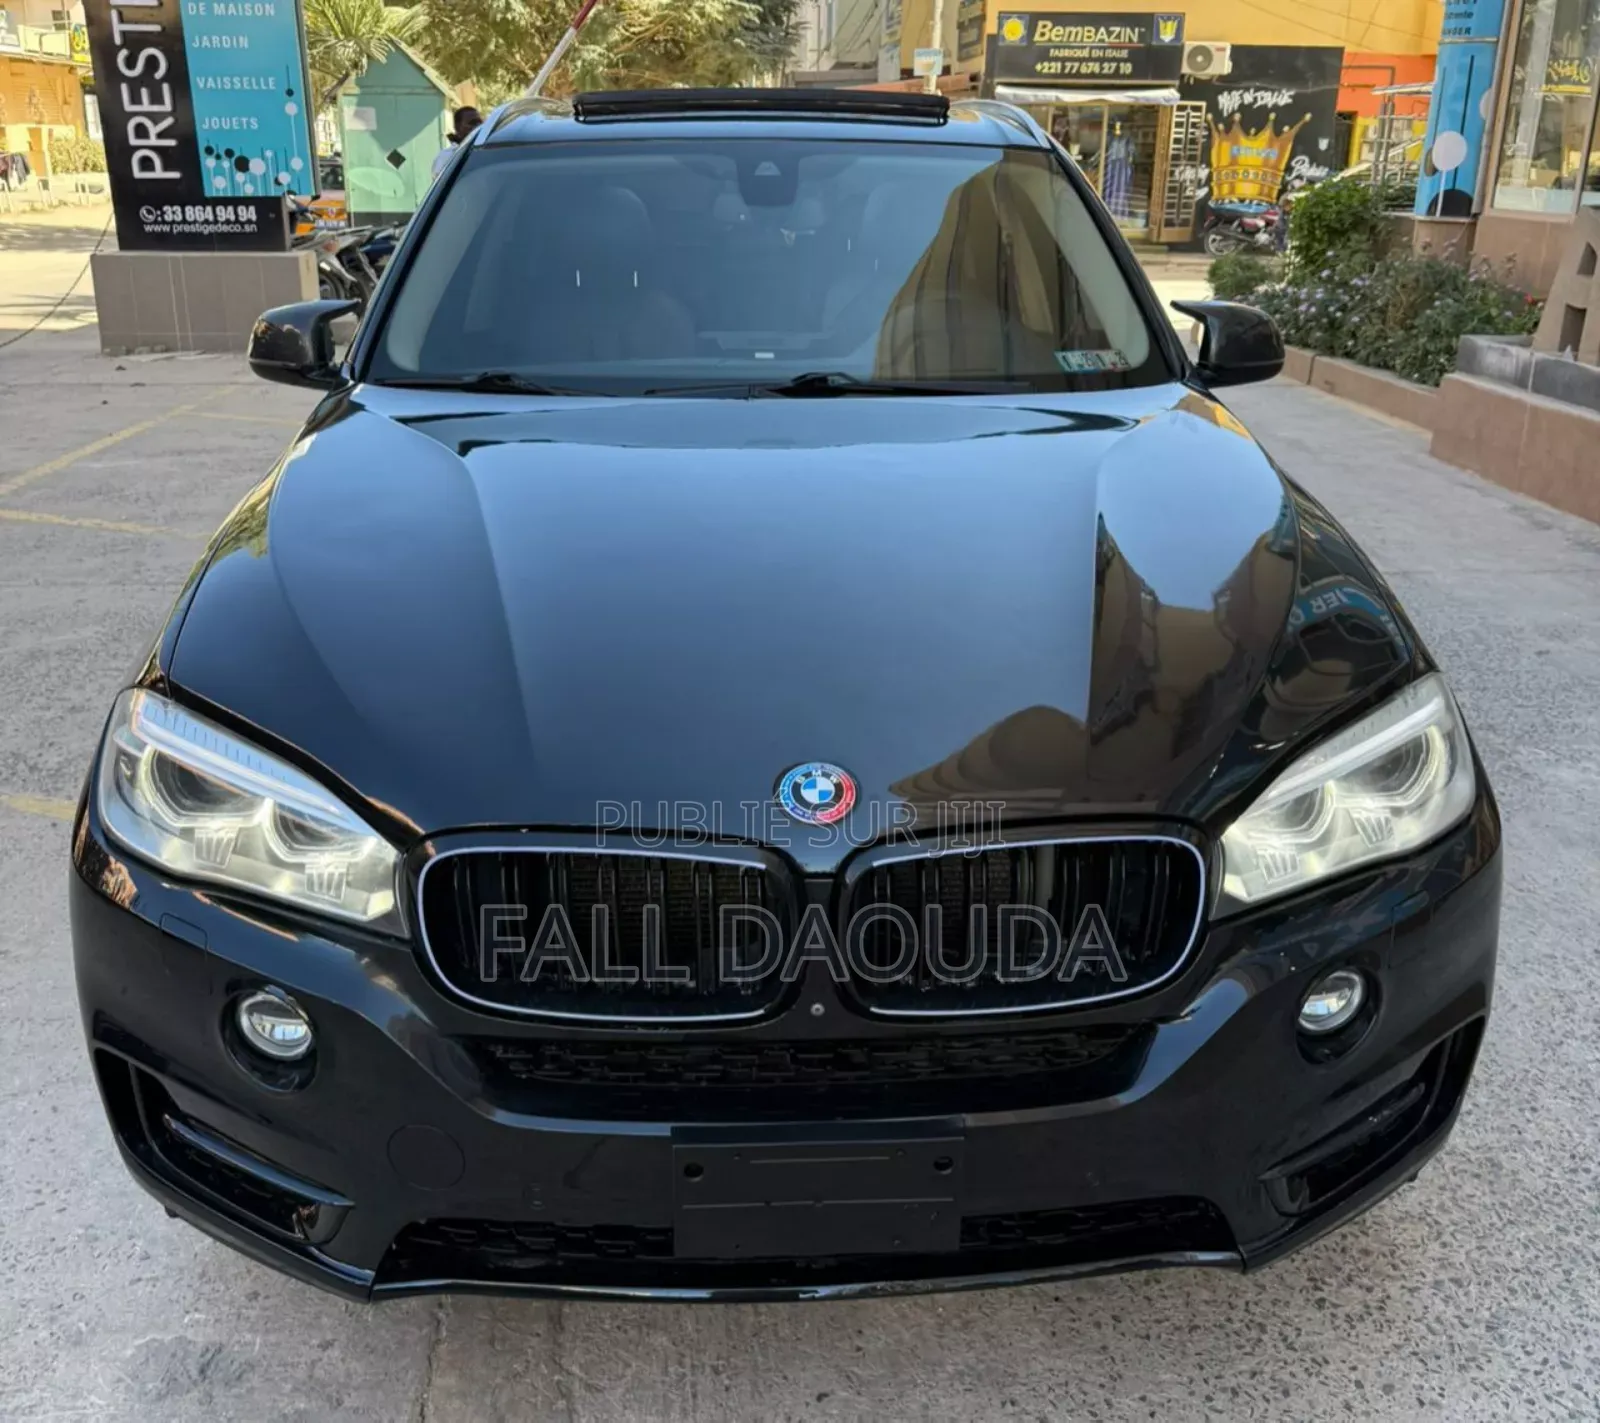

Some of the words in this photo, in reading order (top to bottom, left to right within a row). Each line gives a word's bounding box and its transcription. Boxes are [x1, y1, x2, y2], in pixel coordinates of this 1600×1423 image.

[188, 2, 206, 16] DE
[213, 3, 275, 16] MAISON
[192, 35, 248, 48] JARDIN
[1049, 47, 1090, 58] FABRIQUÉ
[1091, 49, 1104, 58] EN
[1105, 49, 1129, 58] ITALIE
[1035, 62, 1062, 74] +221
[1064, 62, 1079, 74] 77
[1101, 62, 1118, 74] 27
[1120, 62, 1132, 74] 10
[196, 76, 276, 90] VAISSELLE
[202, 116, 258, 130] JOUETS
[185, 205, 214, 222] 864
[215, 205, 236, 222] 94
[237, 205, 257, 222] 94
